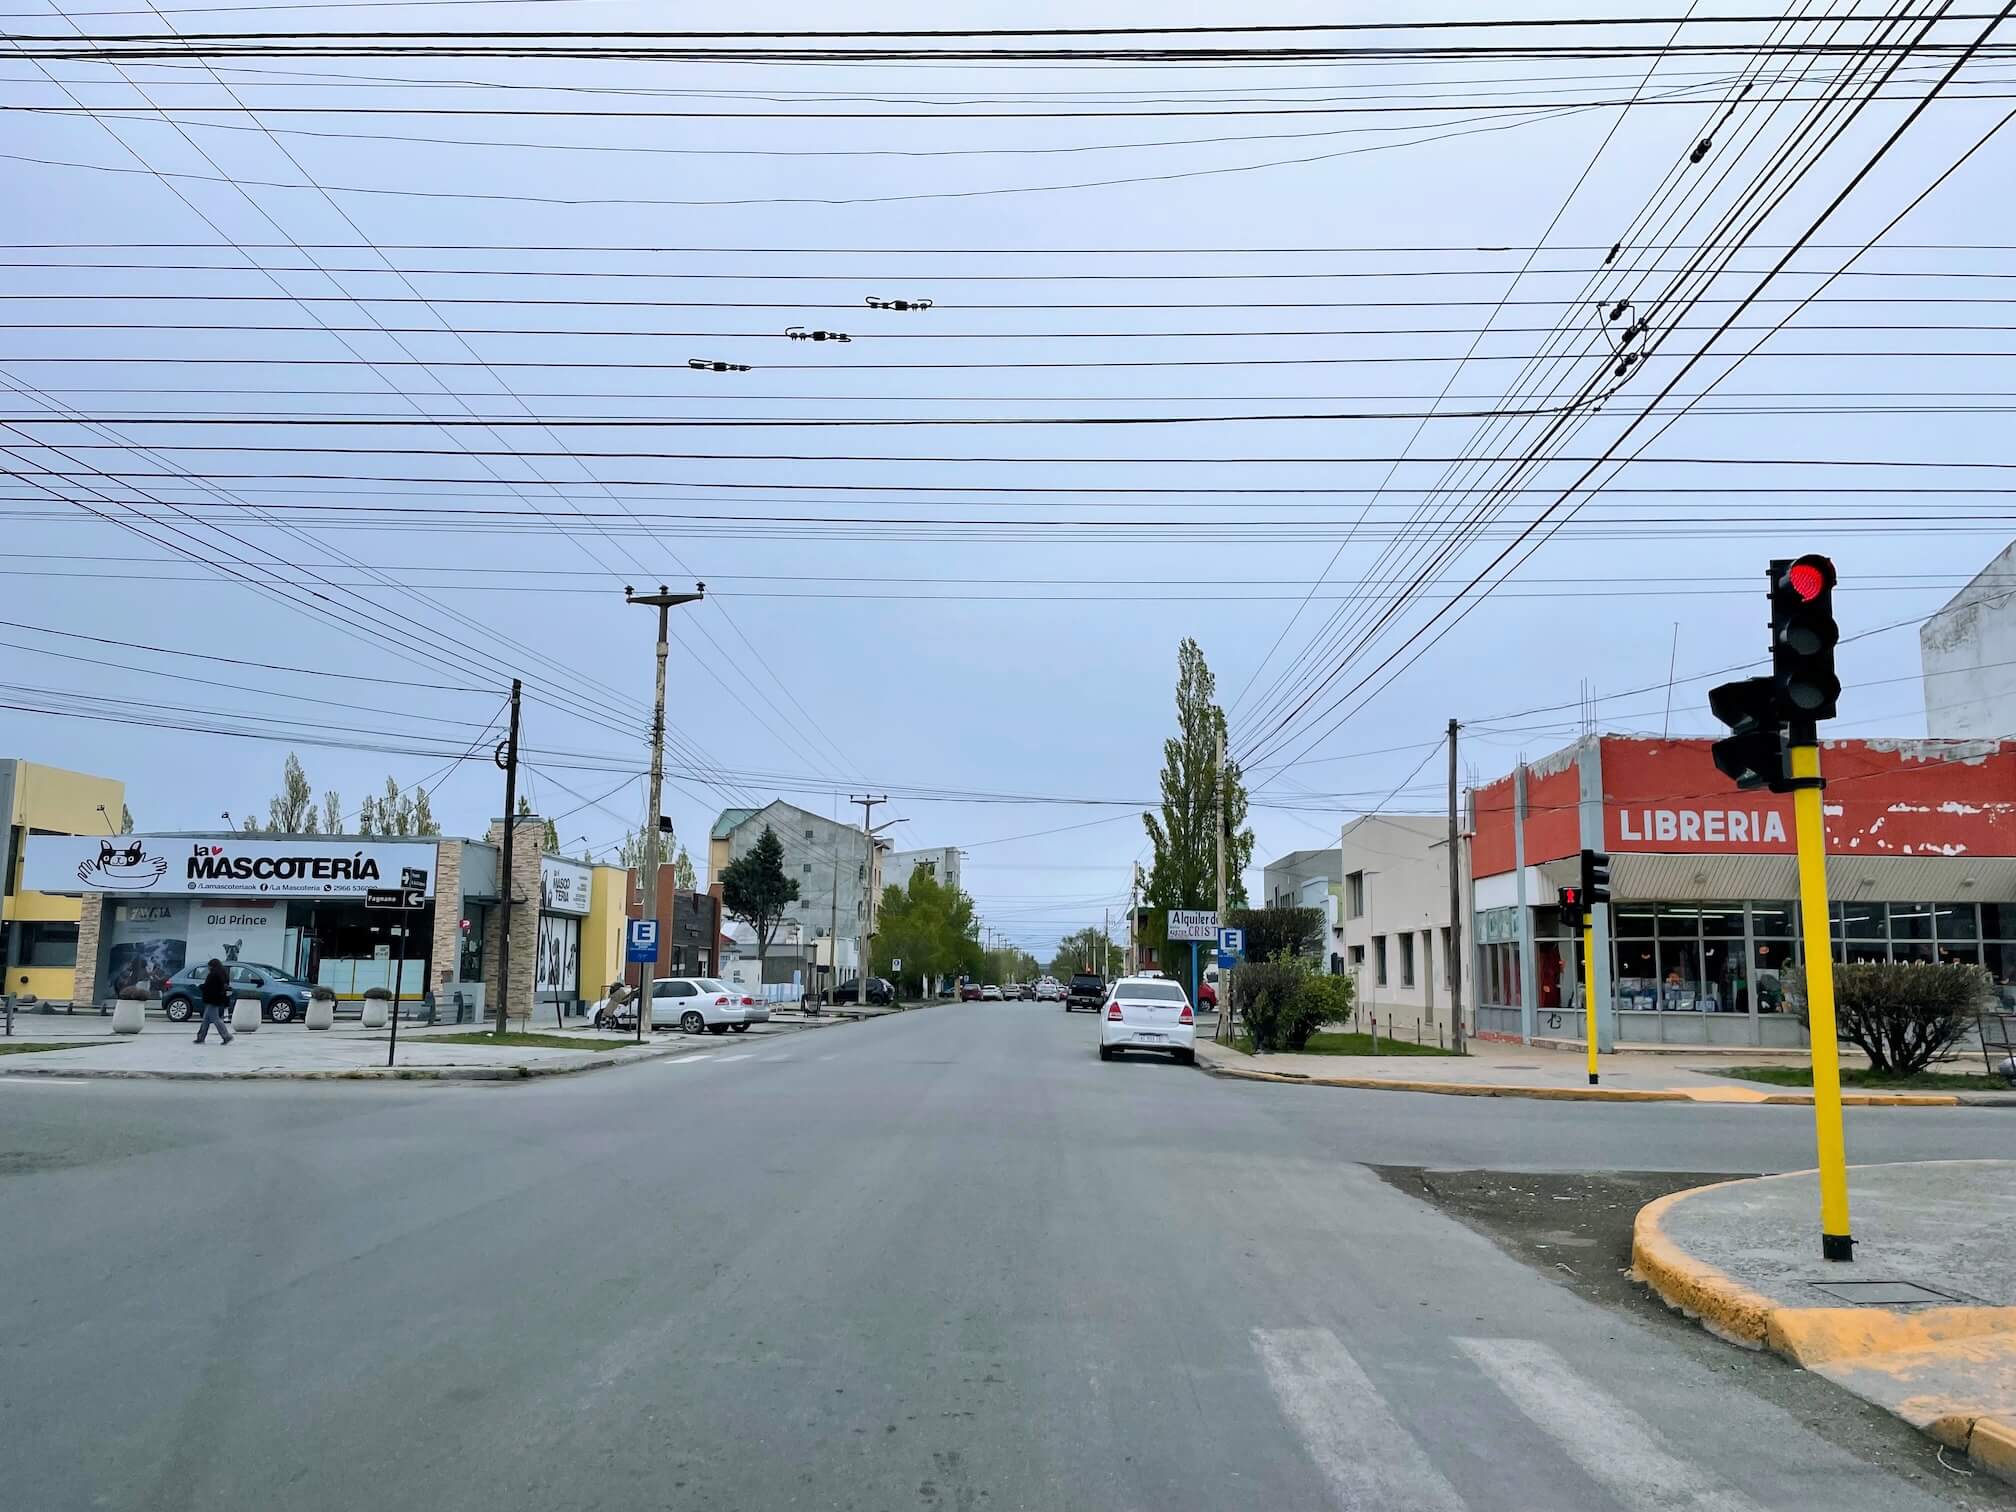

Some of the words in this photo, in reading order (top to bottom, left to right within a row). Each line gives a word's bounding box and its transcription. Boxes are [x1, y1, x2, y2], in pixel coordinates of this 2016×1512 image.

[1620, 809, 1787, 842] LIBRERIA
[193, 843, 209, 856] la
[187, 850, 380, 880] MASCOTERÍA
[207, 914, 226, 926] Old
[229, 914, 267, 926] Prince
[1172, 911, 1209, 927] Alquiler
[637, 923, 651, 941] E
[1224, 931, 1238, 948] E
